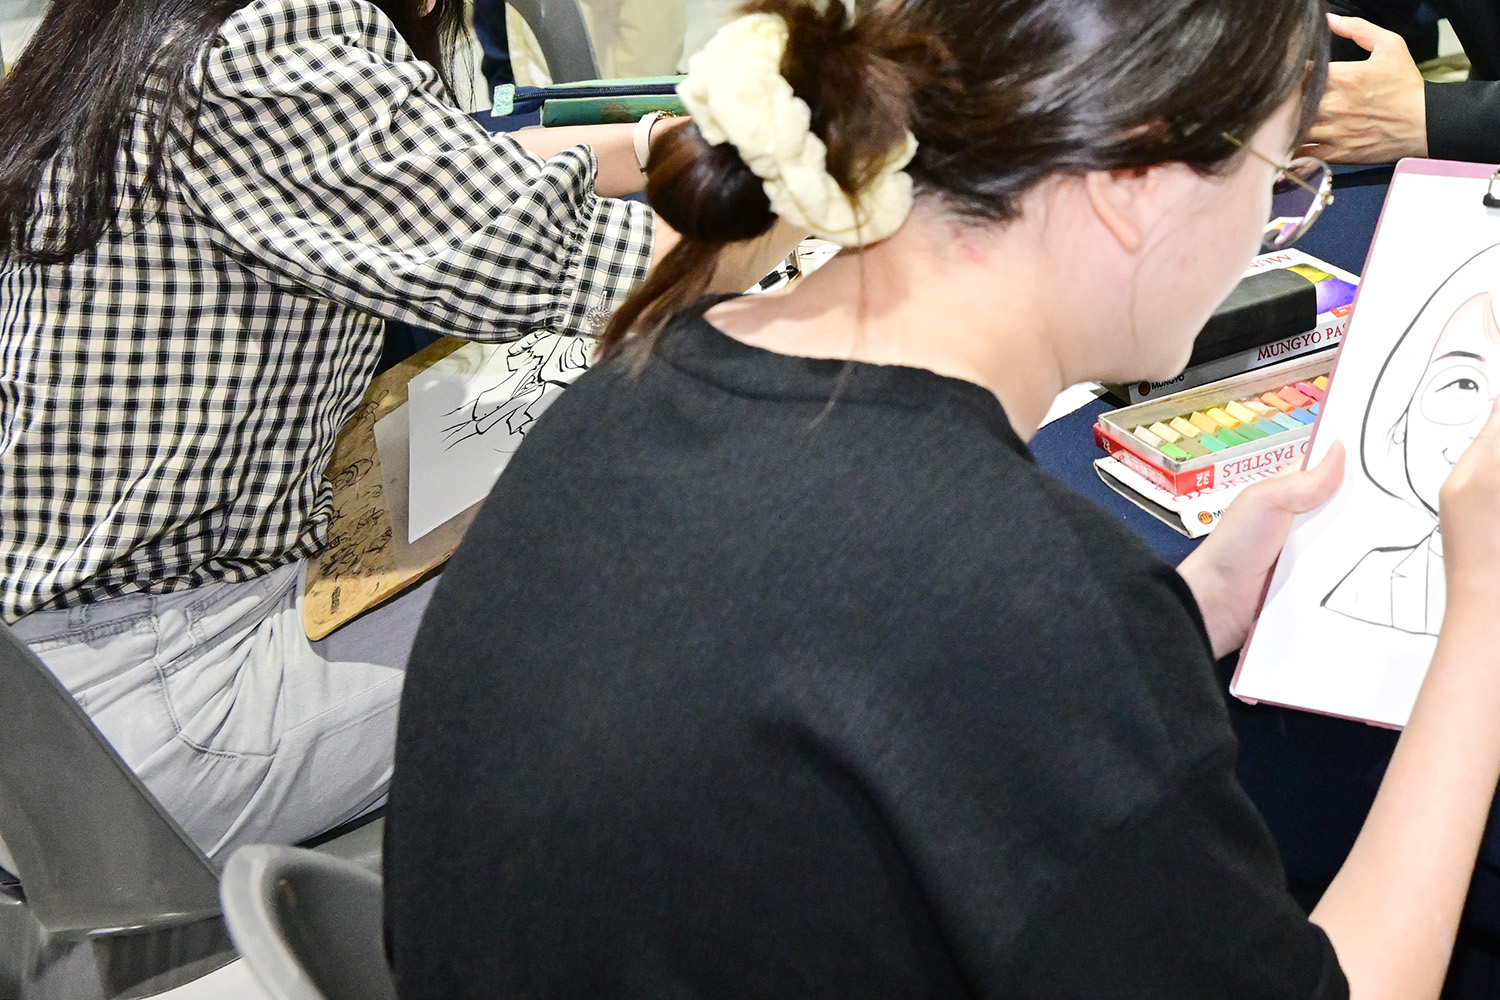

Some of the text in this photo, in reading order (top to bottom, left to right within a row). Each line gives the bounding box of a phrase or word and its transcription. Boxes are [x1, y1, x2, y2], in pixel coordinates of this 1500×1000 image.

[1257, 331, 1322, 361] MUNGYO
[1222, 444, 1294, 478] PASTELS
[1195, 474, 1210, 487] 32
